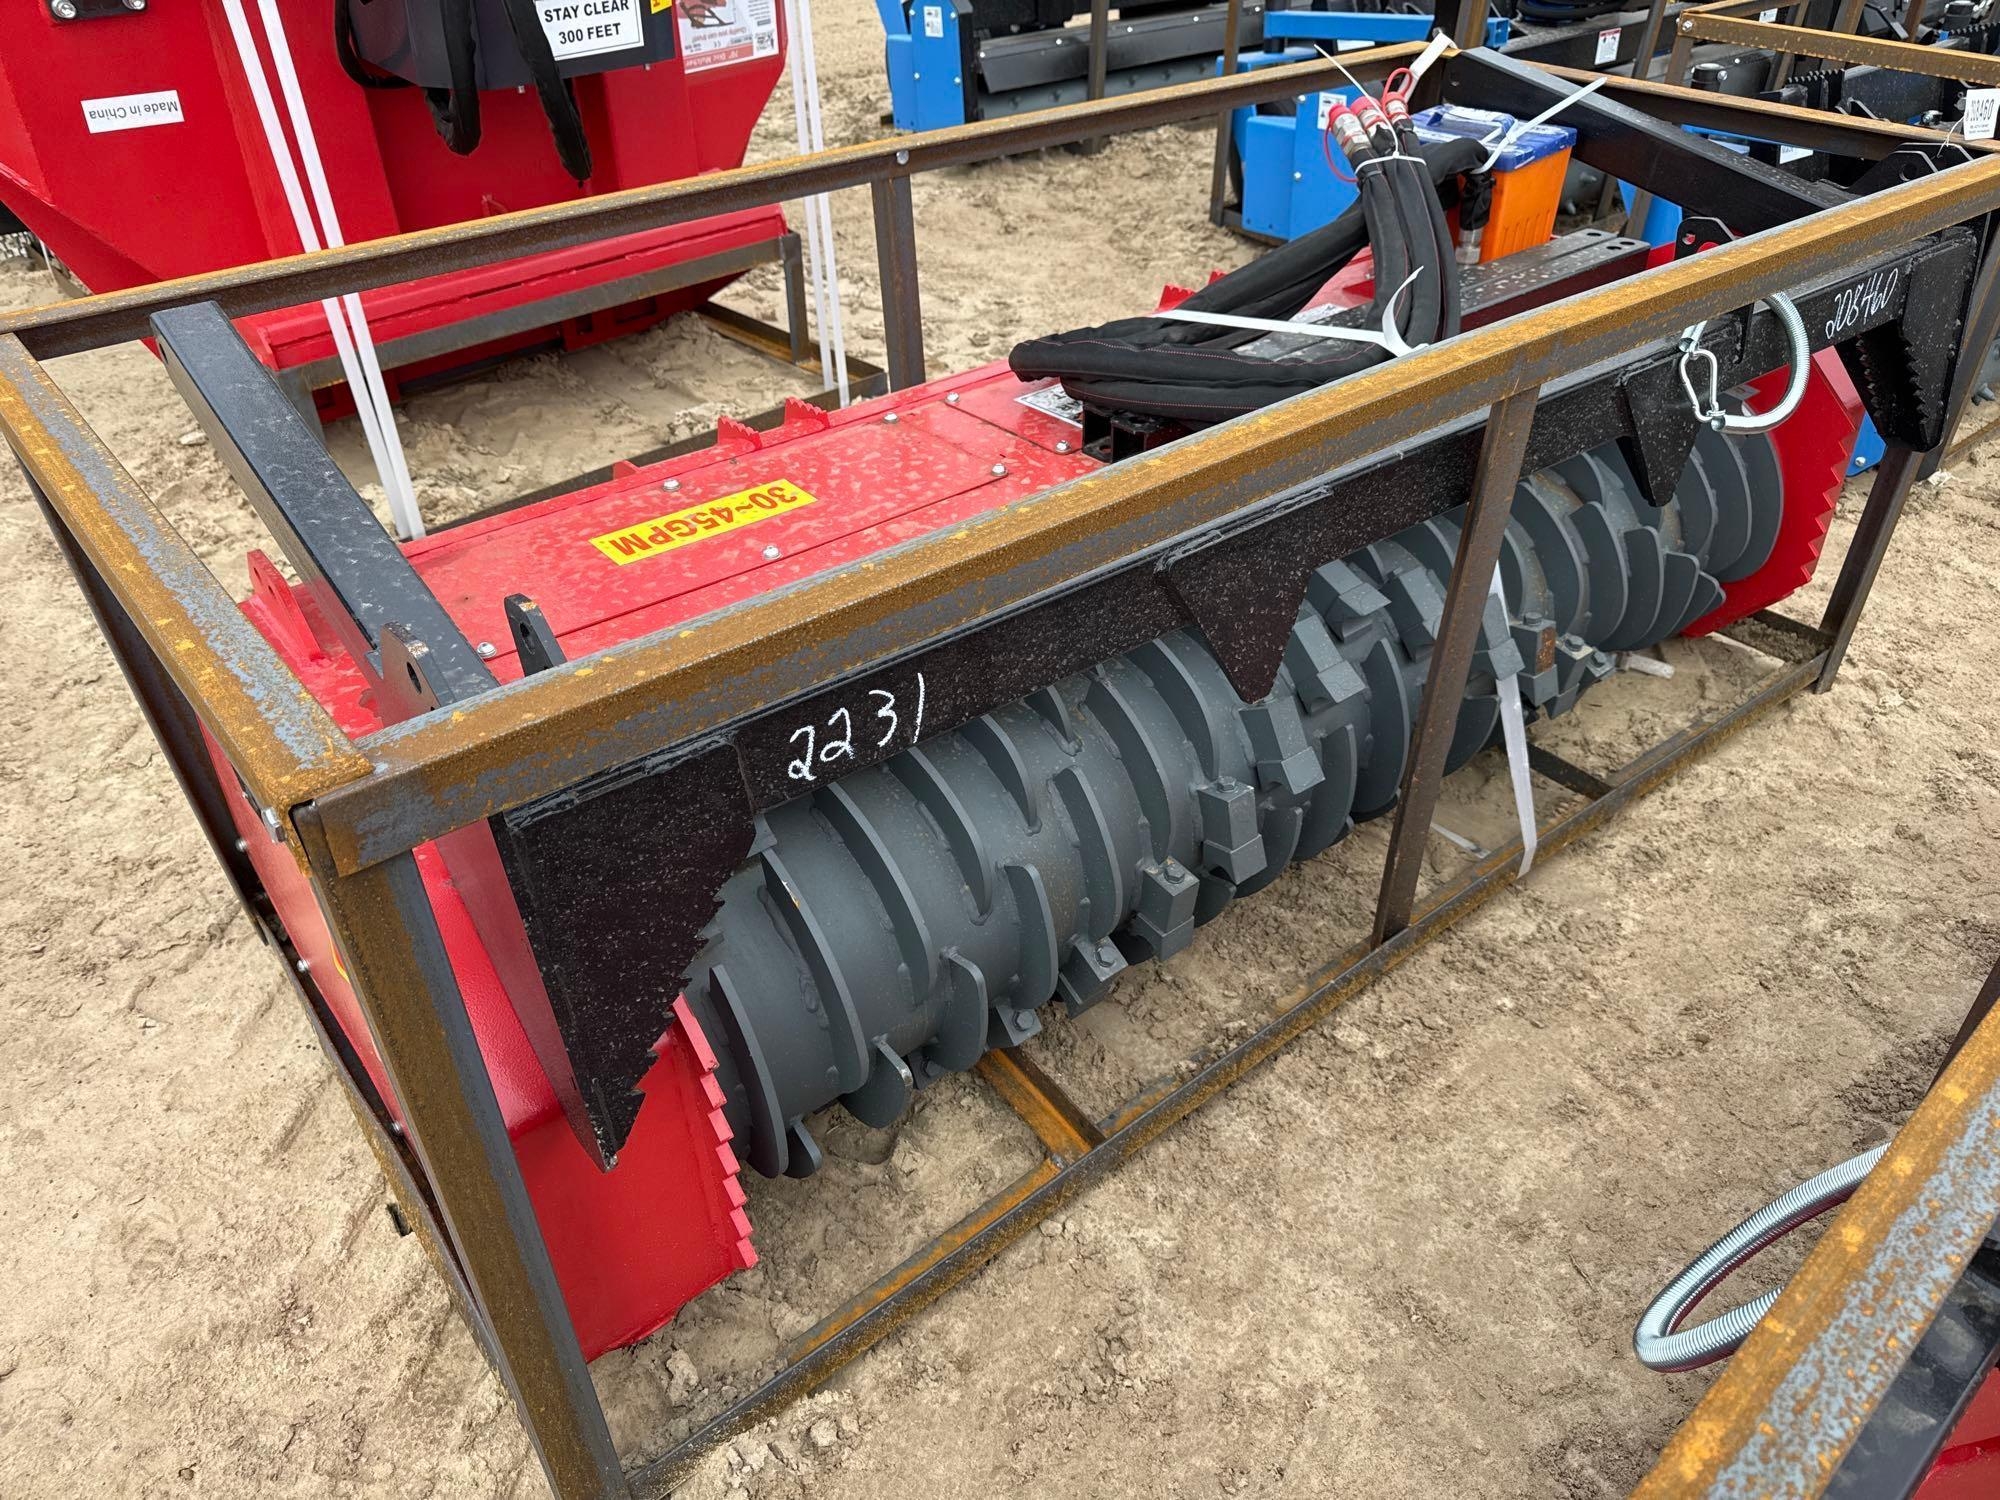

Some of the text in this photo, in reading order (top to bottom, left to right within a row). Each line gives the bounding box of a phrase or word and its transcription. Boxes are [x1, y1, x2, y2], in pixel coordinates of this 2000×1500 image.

[544, 0, 630, 23] STAY CLEAR
[558, 22, 622, 44] 300 FEET
[88, 100, 179, 120] Made in China
[1825, 267, 1899, 340] 208460
[787, 672, 926, 782] 2231
